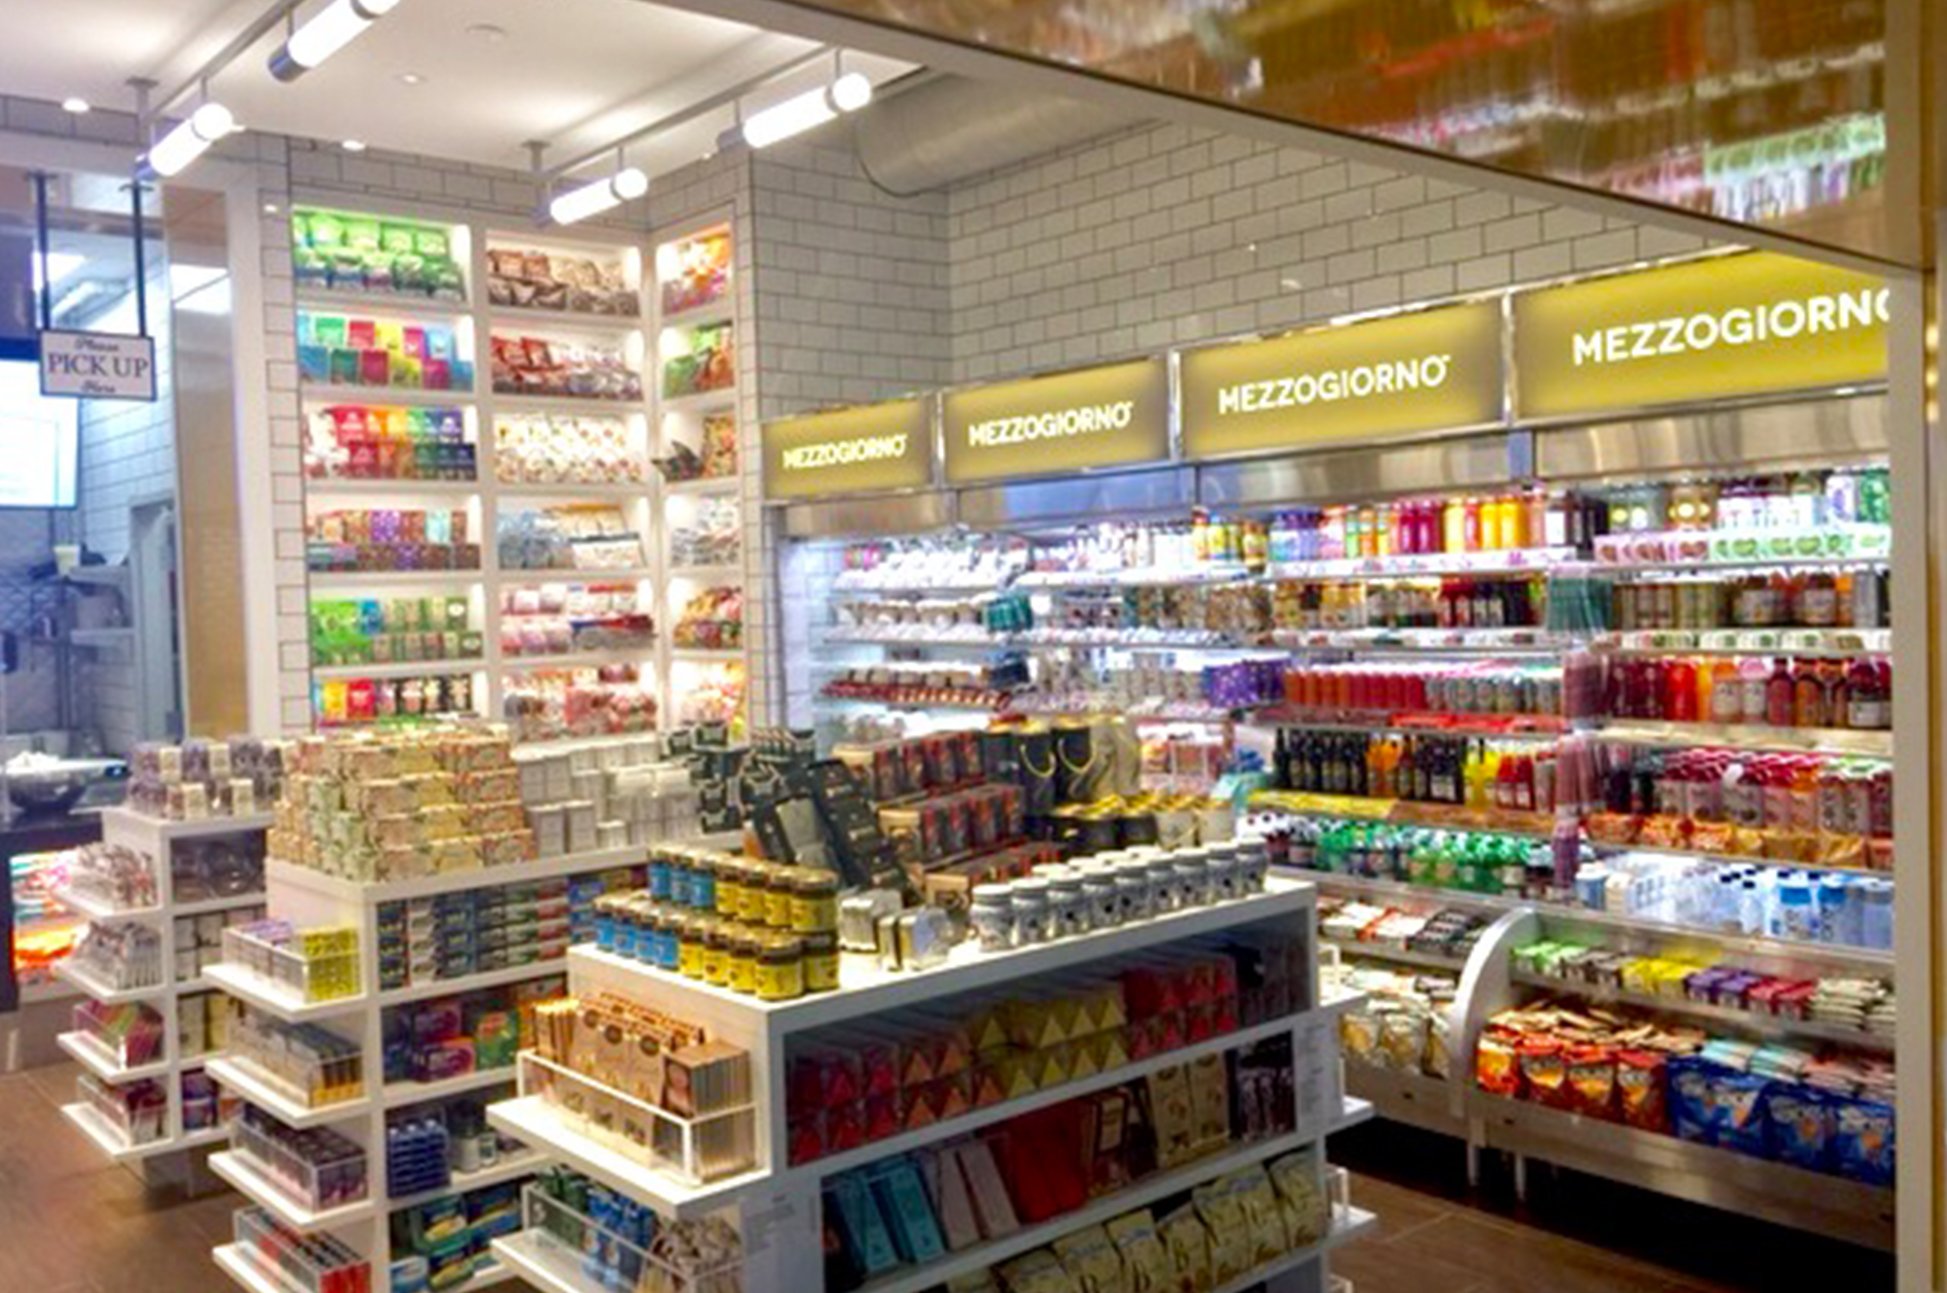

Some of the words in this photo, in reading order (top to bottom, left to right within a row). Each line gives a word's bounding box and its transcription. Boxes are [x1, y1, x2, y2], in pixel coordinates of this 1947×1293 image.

[48, 353, 109, 377] PICK
[112, 355, 149, 379] UP
[1218, 355, 1449, 415] MEZZOGIORNO
[968, 401, 1132, 446] MEZZOGIORNO
[782, 434, 906, 469] MEZZOGIORNO
